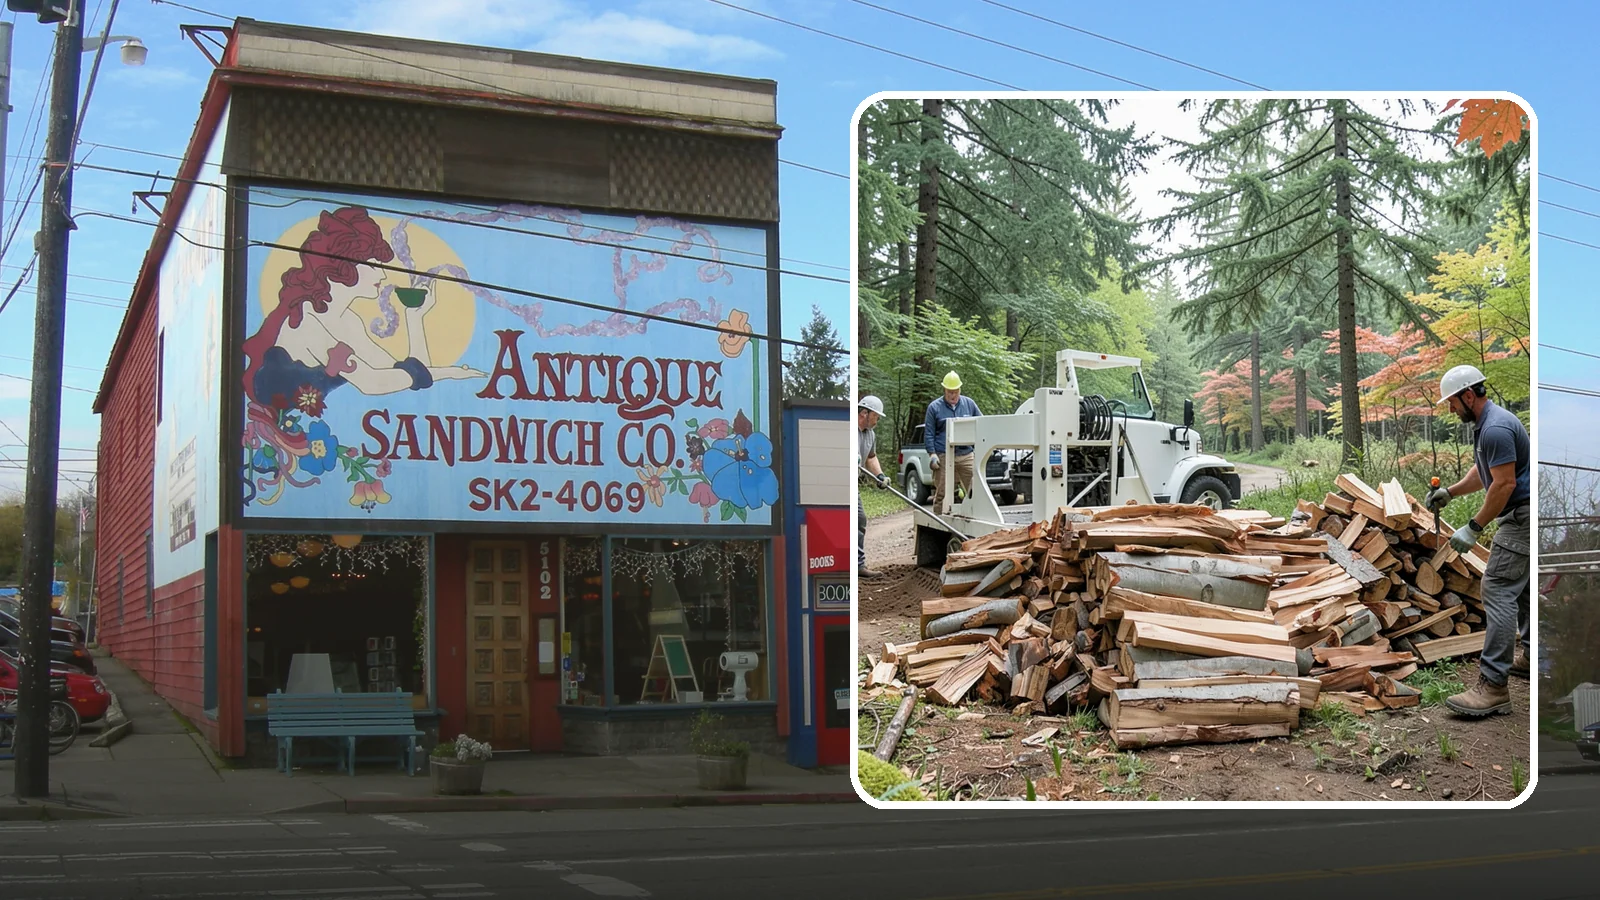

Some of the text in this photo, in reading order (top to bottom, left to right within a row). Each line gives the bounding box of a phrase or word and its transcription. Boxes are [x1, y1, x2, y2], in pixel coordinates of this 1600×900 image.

[476, 329, 723, 421] ANTIQUE
[361, 408, 686, 469] SANDWICH CO.
[468, 476, 645, 513] SK2-4069
[539, 542, 551, 600] 5102
[809, 555, 835, 569] BOOKS
